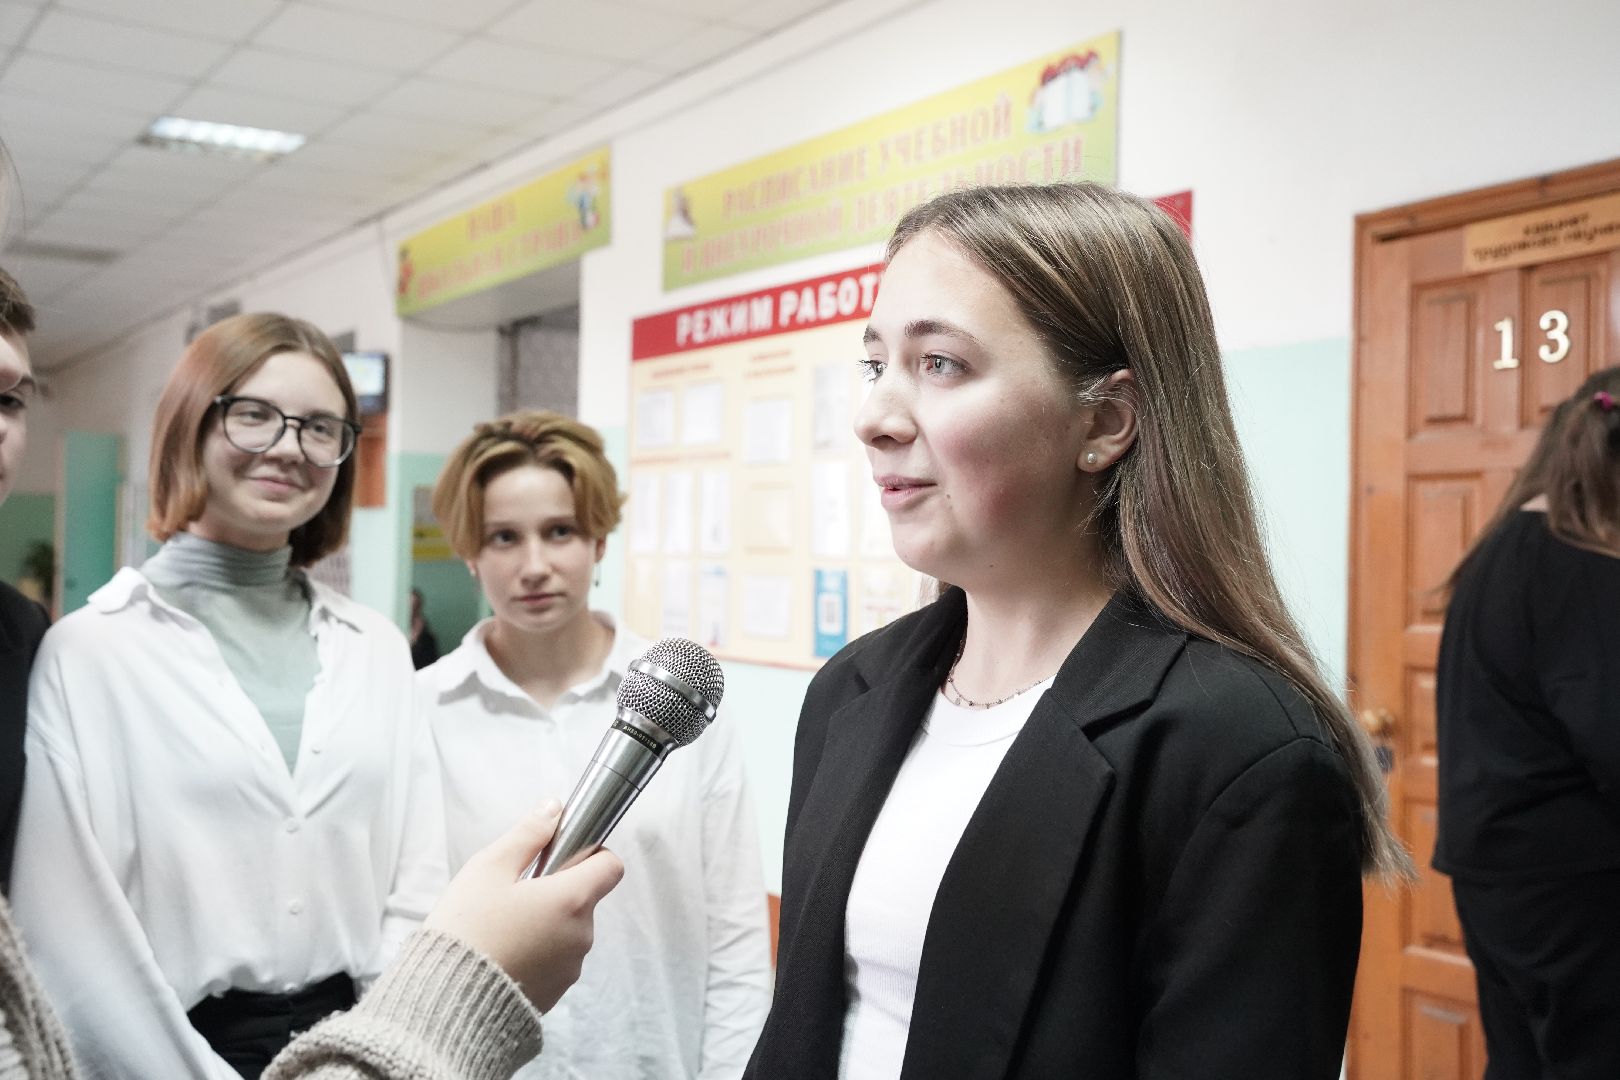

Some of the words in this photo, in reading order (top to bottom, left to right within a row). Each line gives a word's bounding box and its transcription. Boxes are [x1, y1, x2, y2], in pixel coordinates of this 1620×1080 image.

[879, 90, 1012, 175] УЧЕБНОЙ
[676, 294, 774, 346] РЕЖИМ
[778, 271, 881, 327] РАБОТ
